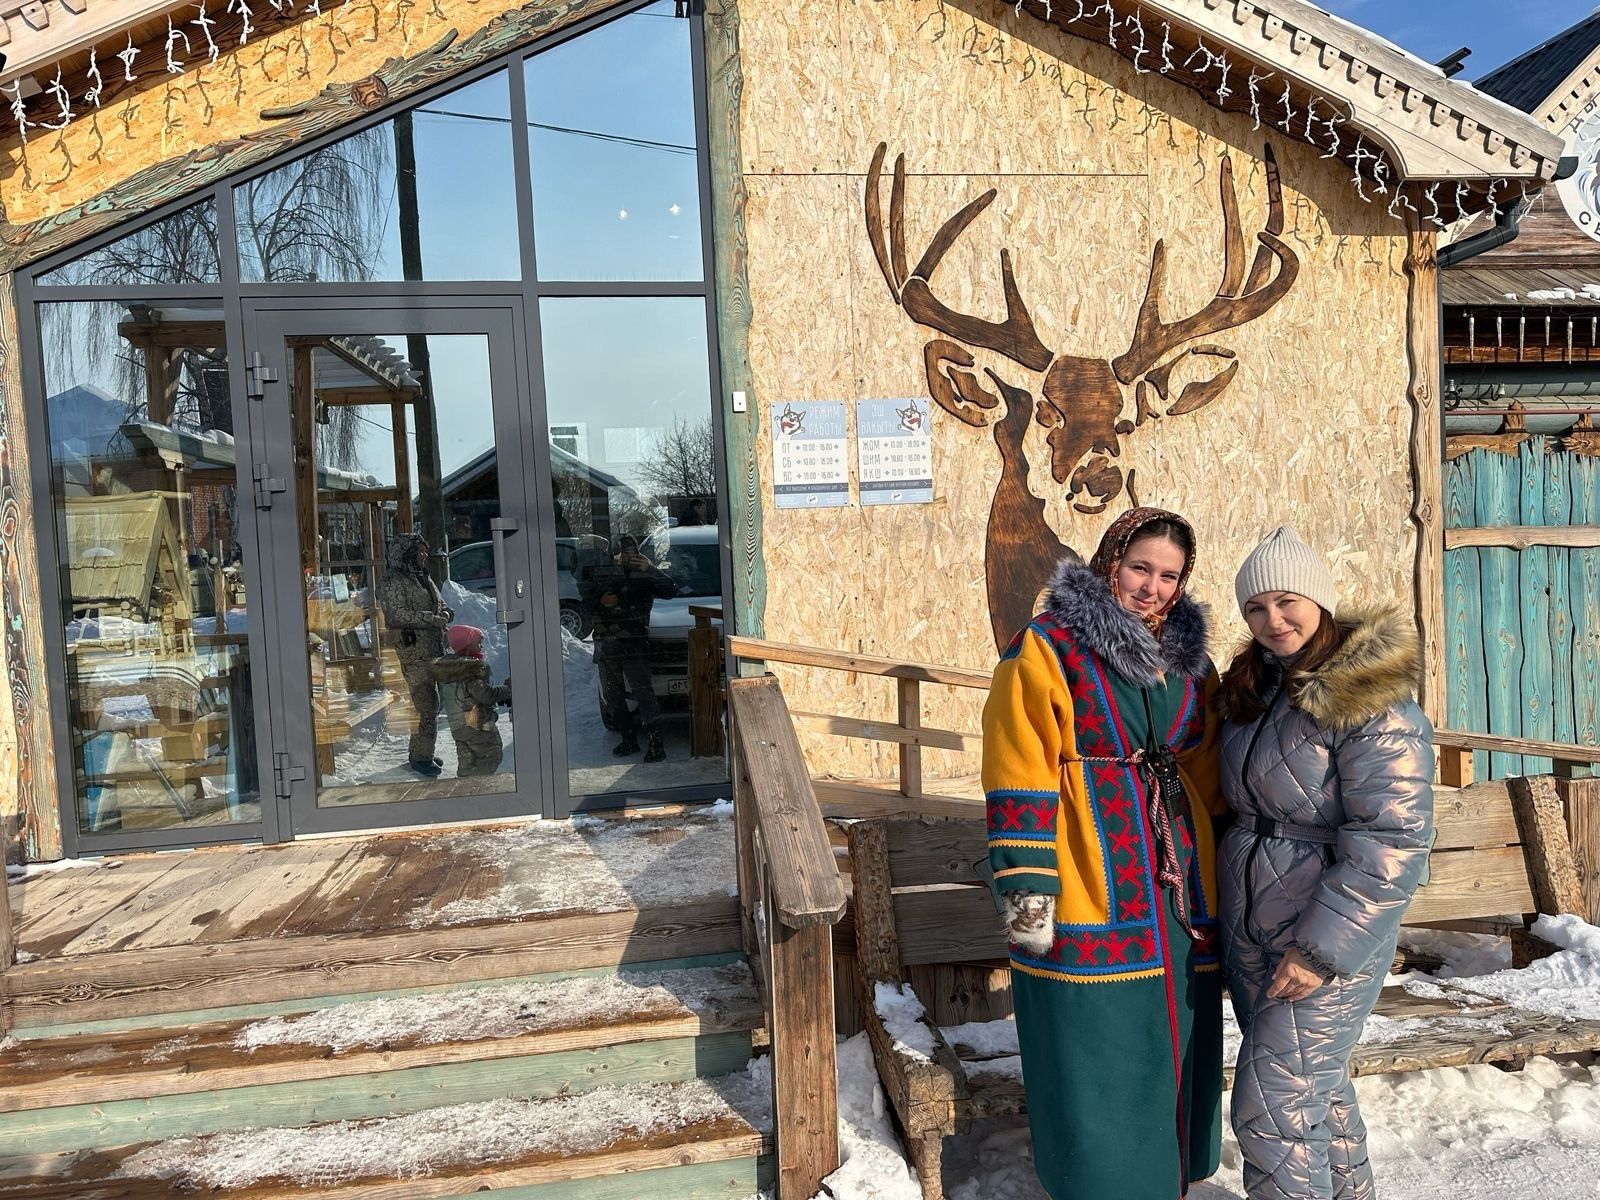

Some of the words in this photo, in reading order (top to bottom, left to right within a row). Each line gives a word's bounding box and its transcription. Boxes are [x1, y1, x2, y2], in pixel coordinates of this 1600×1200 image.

[809, 405, 840, 420] РЕЖИМ
[871, 403, 884, 417] ЭШ
[809, 422, 842, 436] РАБОТЫ
[860, 420, 896, 435] ВАКЫТЫ
[782, 442, 790, 454] ПТ
[862, 439, 880, 451] ЖОМ
[782, 456, 791, 468] СБ
[783, 471, 792, 482] ВС
[863, 468, 881, 479] ЯКШ
